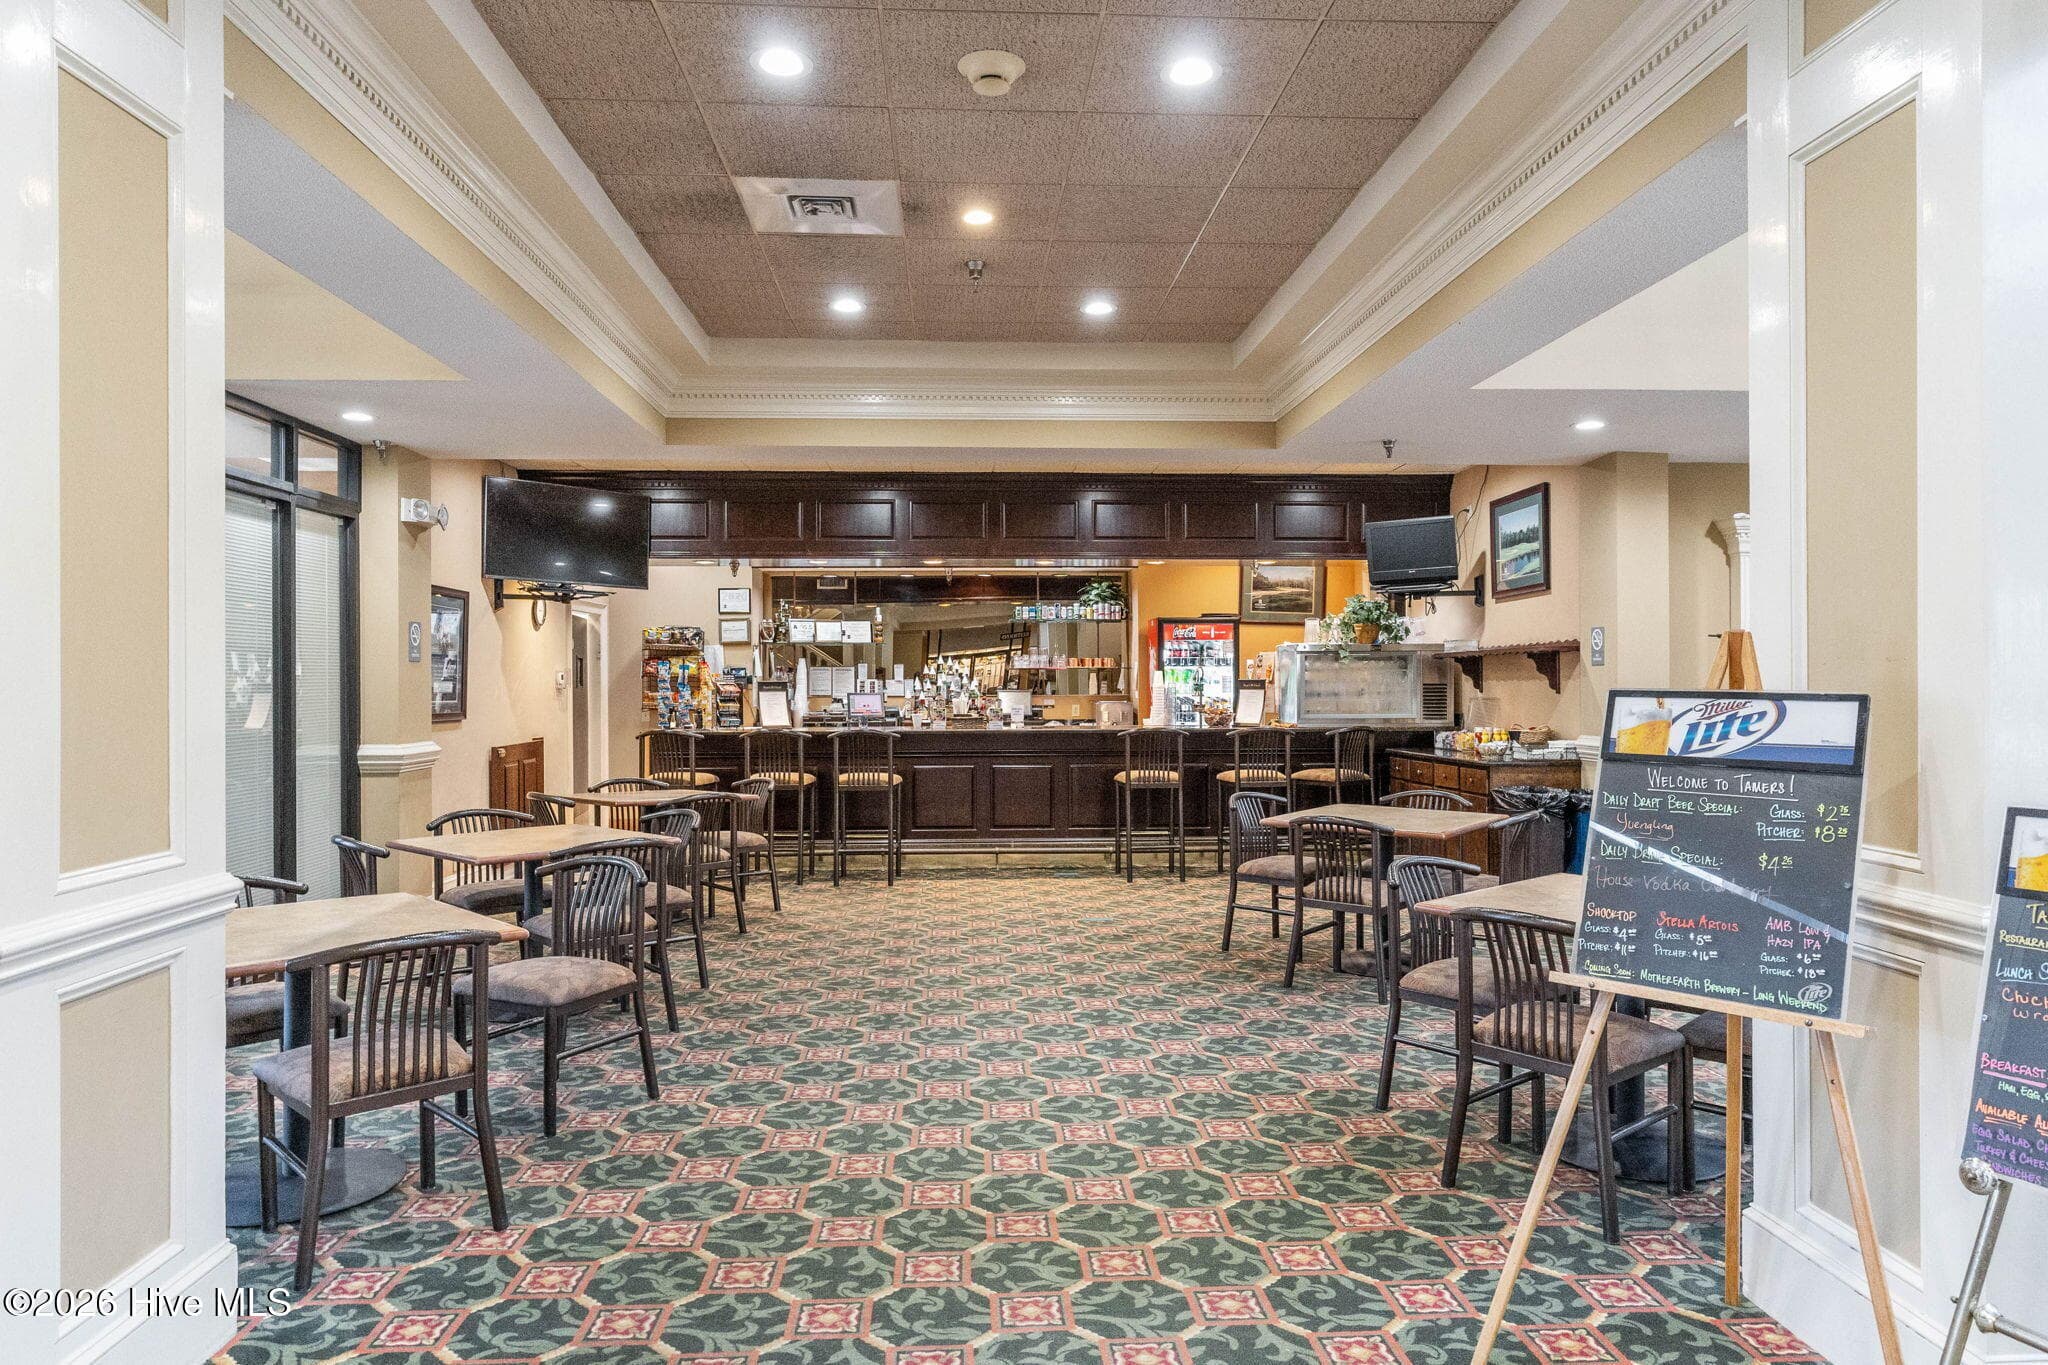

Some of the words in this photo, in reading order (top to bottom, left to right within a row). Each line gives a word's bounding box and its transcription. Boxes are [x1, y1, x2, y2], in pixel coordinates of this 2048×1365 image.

[1693, 700, 1753, 719] Miller
[1679, 711, 1768, 756] Lite
[1647, 767, 1708, 788] WELCOME
[1714, 778, 1729, 790] TO
[1603, 791, 1629, 807] DAILY
[1632, 792, 1664, 809] DRAFT
[1667, 794, 1695, 811] BEER
[1770, 804, 1805, 820] GLASS:
[1616, 812, 1674, 841] Yuengling
[1756, 822, 1805, 838] PITCHER:
[1600, 840, 1629, 859] DAILY
[1593, 865, 1634, 888] House
[1643, 875, 1691, 892] Vodka
[1656, 911, 1695, 929] STELLA
[1698, 914, 1740, 932] ARTOIS
[1764, 916, 1793, 932] AMB
[1767, 934, 1794, 949] HAZY
[1803, 937, 1822, 951] IPA
[1995, 958, 2033, 980] LUNCH
[1703, 978, 1741, 997] BREWERY
[1753, 985, 1775, 1005] LONG
[1975, 1097, 2029, 1125] AVAILABLE
